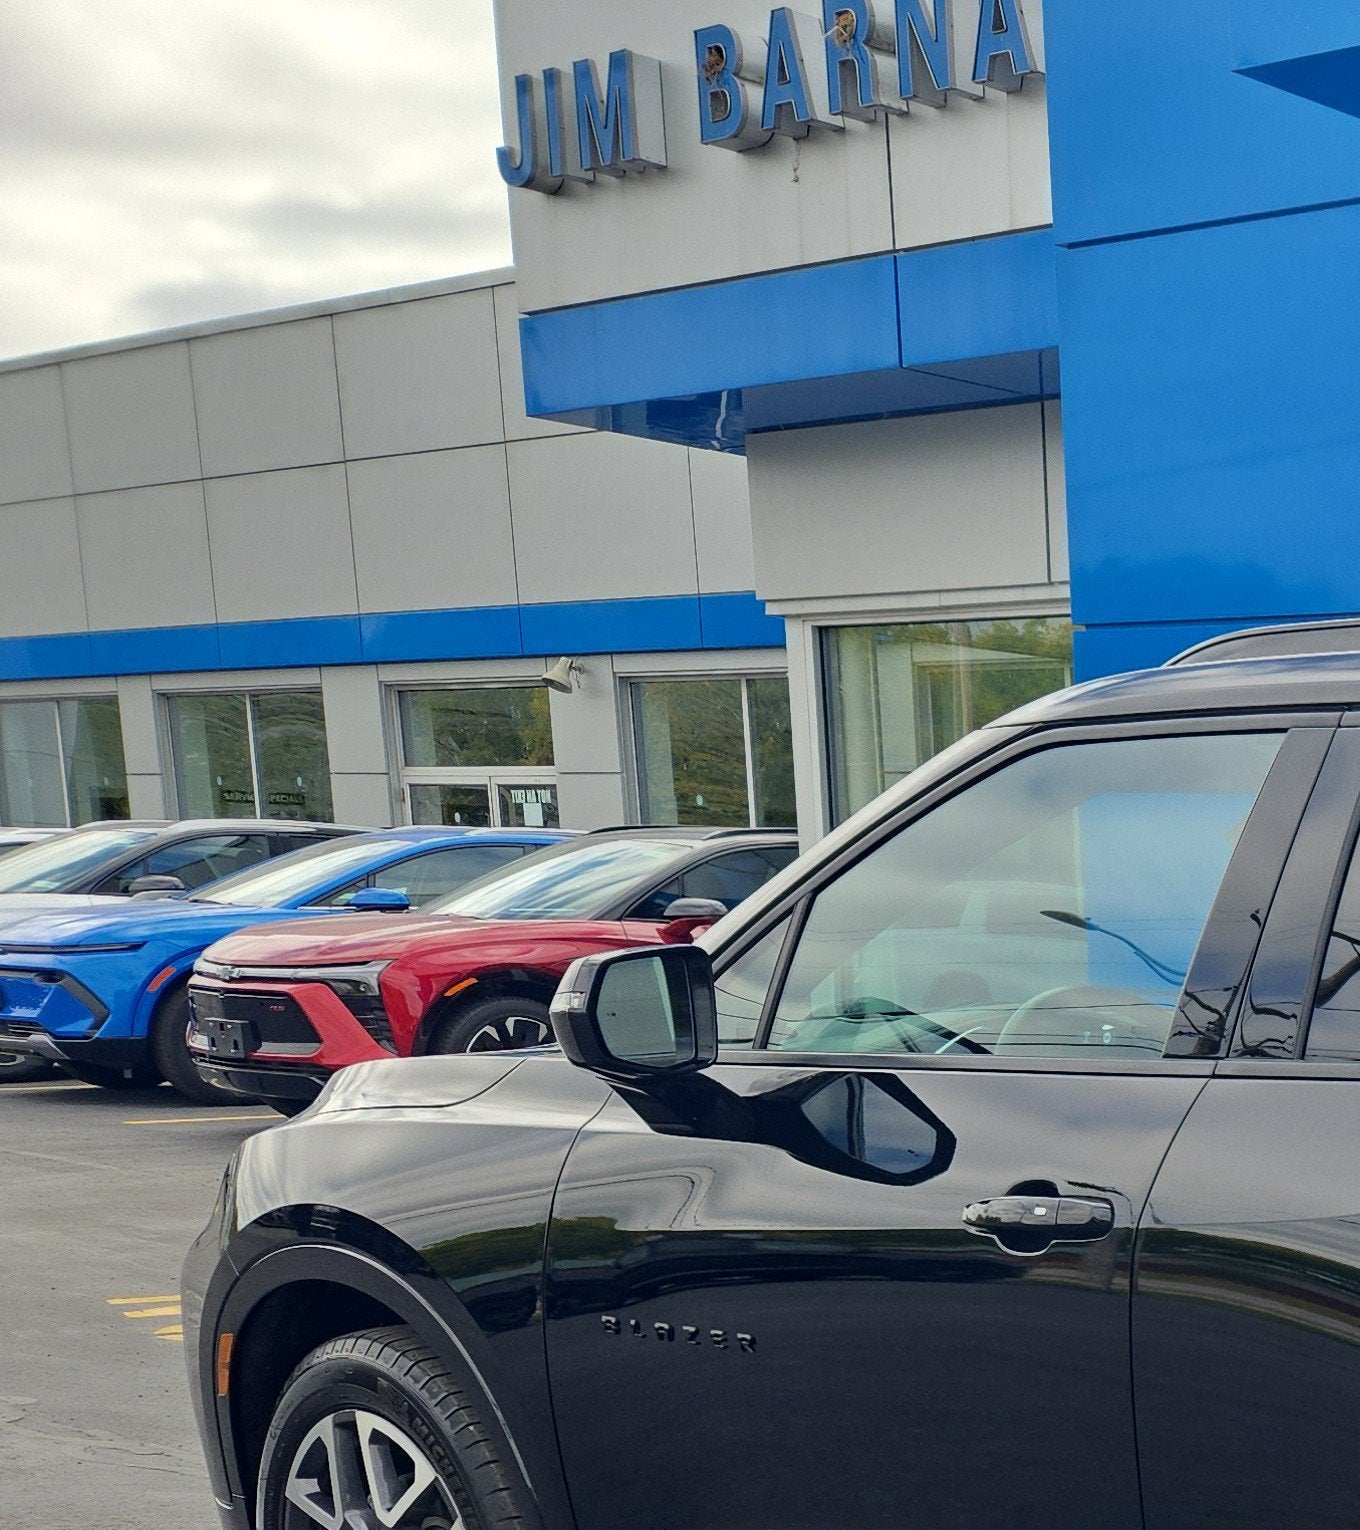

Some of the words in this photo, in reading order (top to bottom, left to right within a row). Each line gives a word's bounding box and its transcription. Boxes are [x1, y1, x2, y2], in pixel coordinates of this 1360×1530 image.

[496, 48, 645, 190] JIM
[694, 0, 1036, 146] BARNA
[601, 1315, 756, 1354] BLAZER
